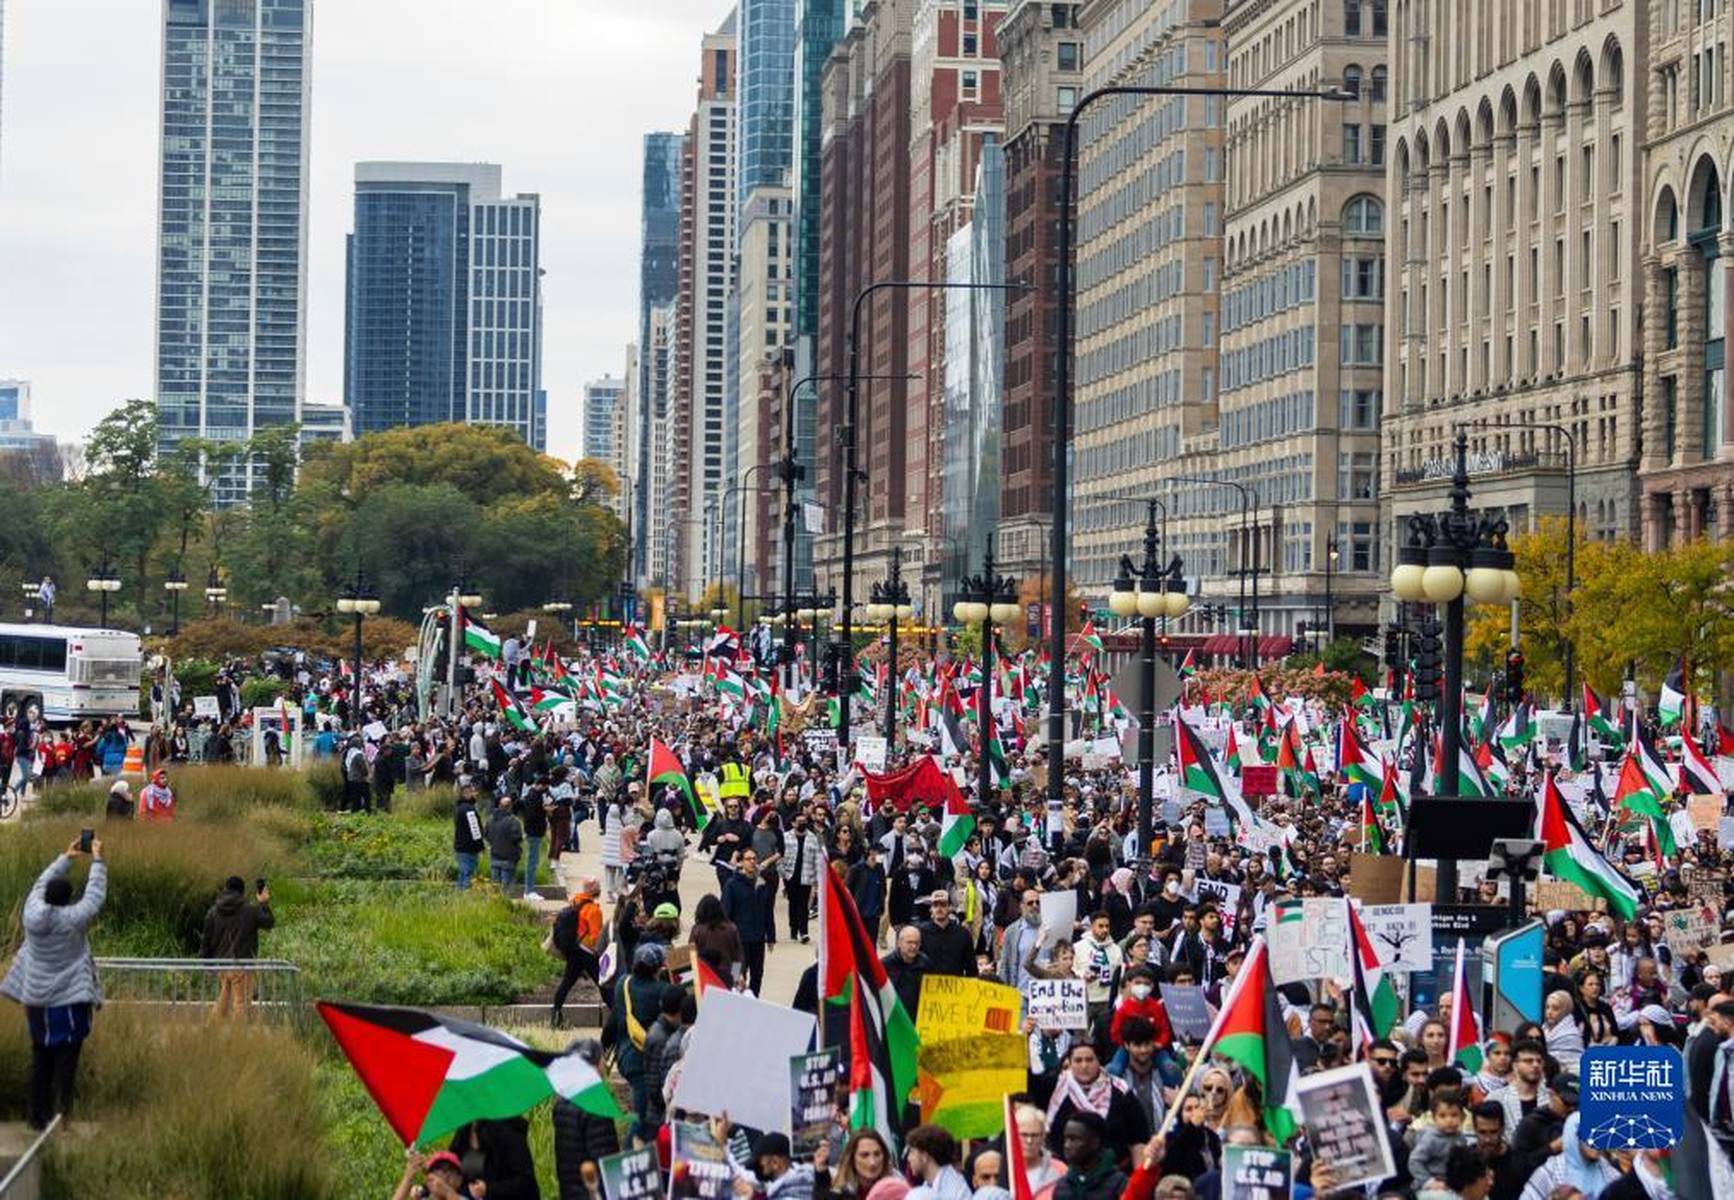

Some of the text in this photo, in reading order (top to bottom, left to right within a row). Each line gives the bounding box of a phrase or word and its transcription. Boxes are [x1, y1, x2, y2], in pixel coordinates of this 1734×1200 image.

[1030, 981, 1083, 999] End the
[805, 1054, 832, 1071] STOP
[813, 1088, 828, 1103] TO
[622, 1152, 649, 1176] STOP
[1242, 1149, 1276, 1167] STOP
[1236, 1167, 1284, 1188] U.S. AID
[1251, 1187, 1270, 1200] TO
